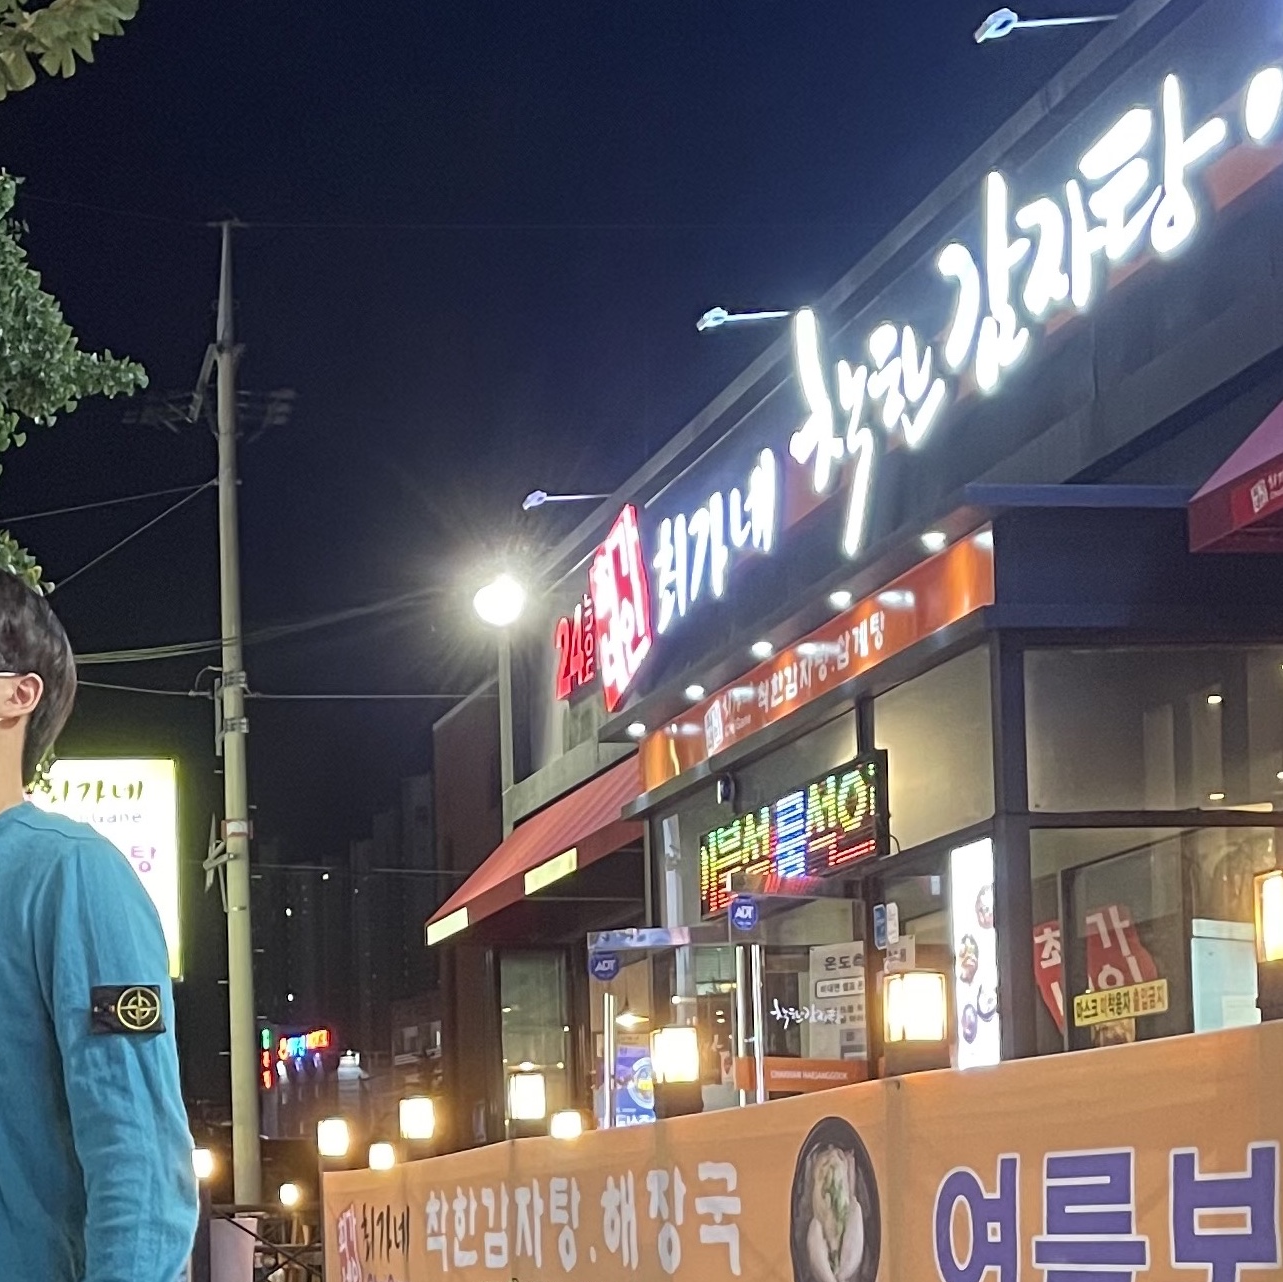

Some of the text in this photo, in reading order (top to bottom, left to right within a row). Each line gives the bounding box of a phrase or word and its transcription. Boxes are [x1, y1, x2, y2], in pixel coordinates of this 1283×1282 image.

[653, 446, 777, 635] 최가네
[555, 603, 584, 700] 24
[734, 905, 754, 919] ADT
[594, 959, 616, 971] ADT
[1076, 998, 1099, 1022] 마스크
